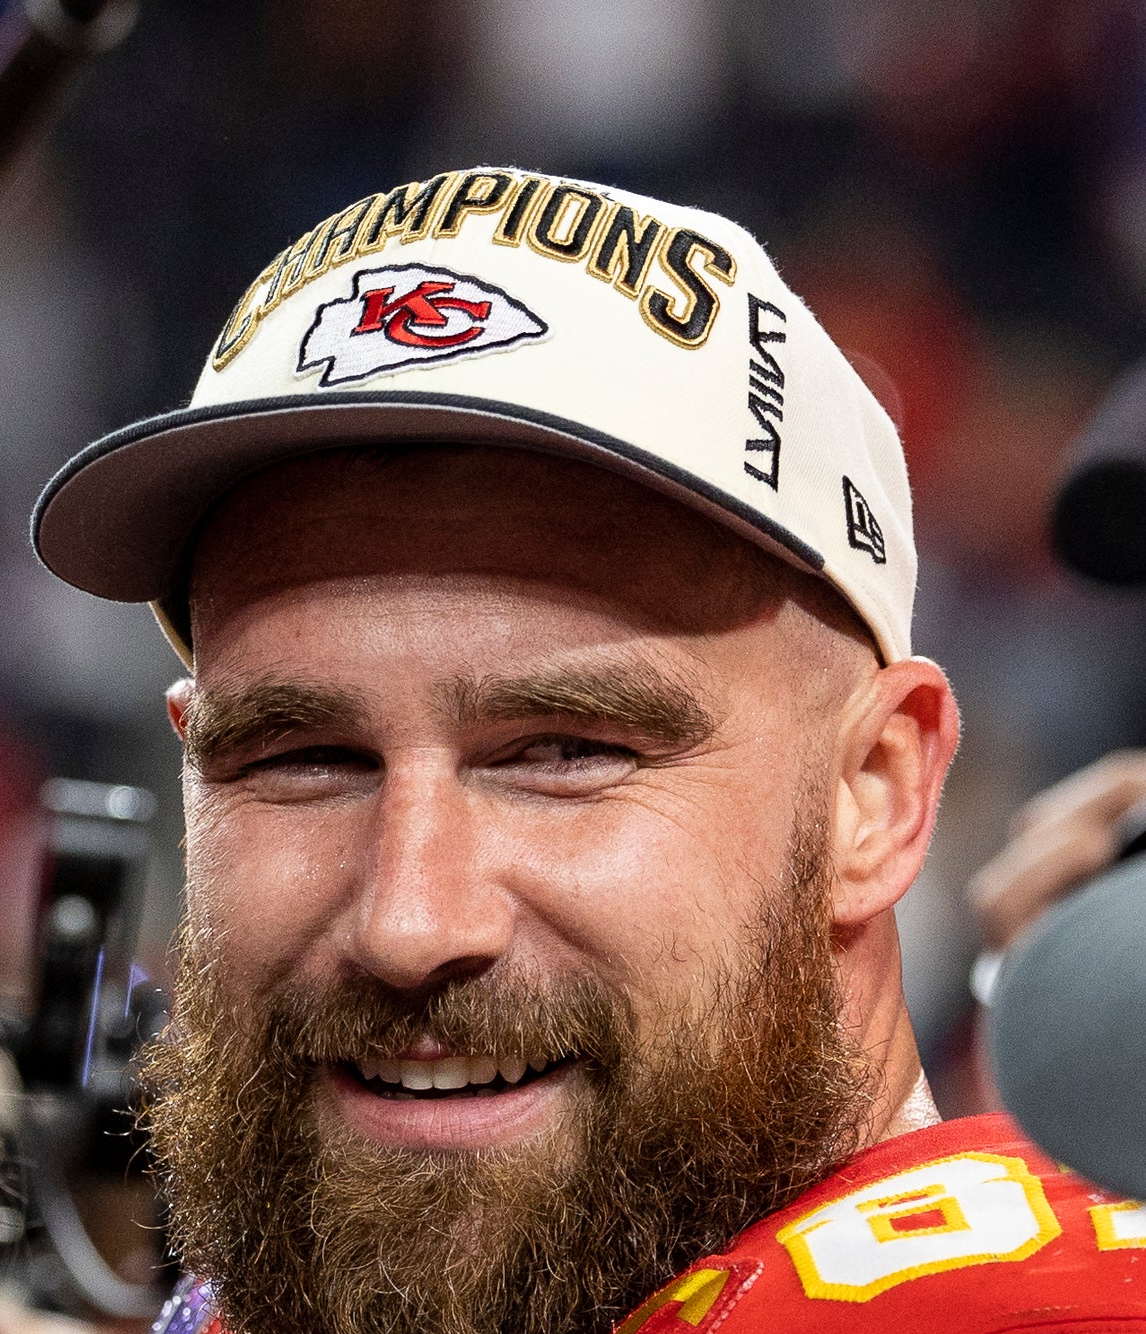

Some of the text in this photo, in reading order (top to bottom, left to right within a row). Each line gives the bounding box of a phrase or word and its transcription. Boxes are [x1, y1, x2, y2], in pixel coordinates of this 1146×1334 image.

[213, 168, 739, 372] CHAMPIONS
[350, 280, 494, 349] KC
[775, 1150, 1146, 1303] 8
